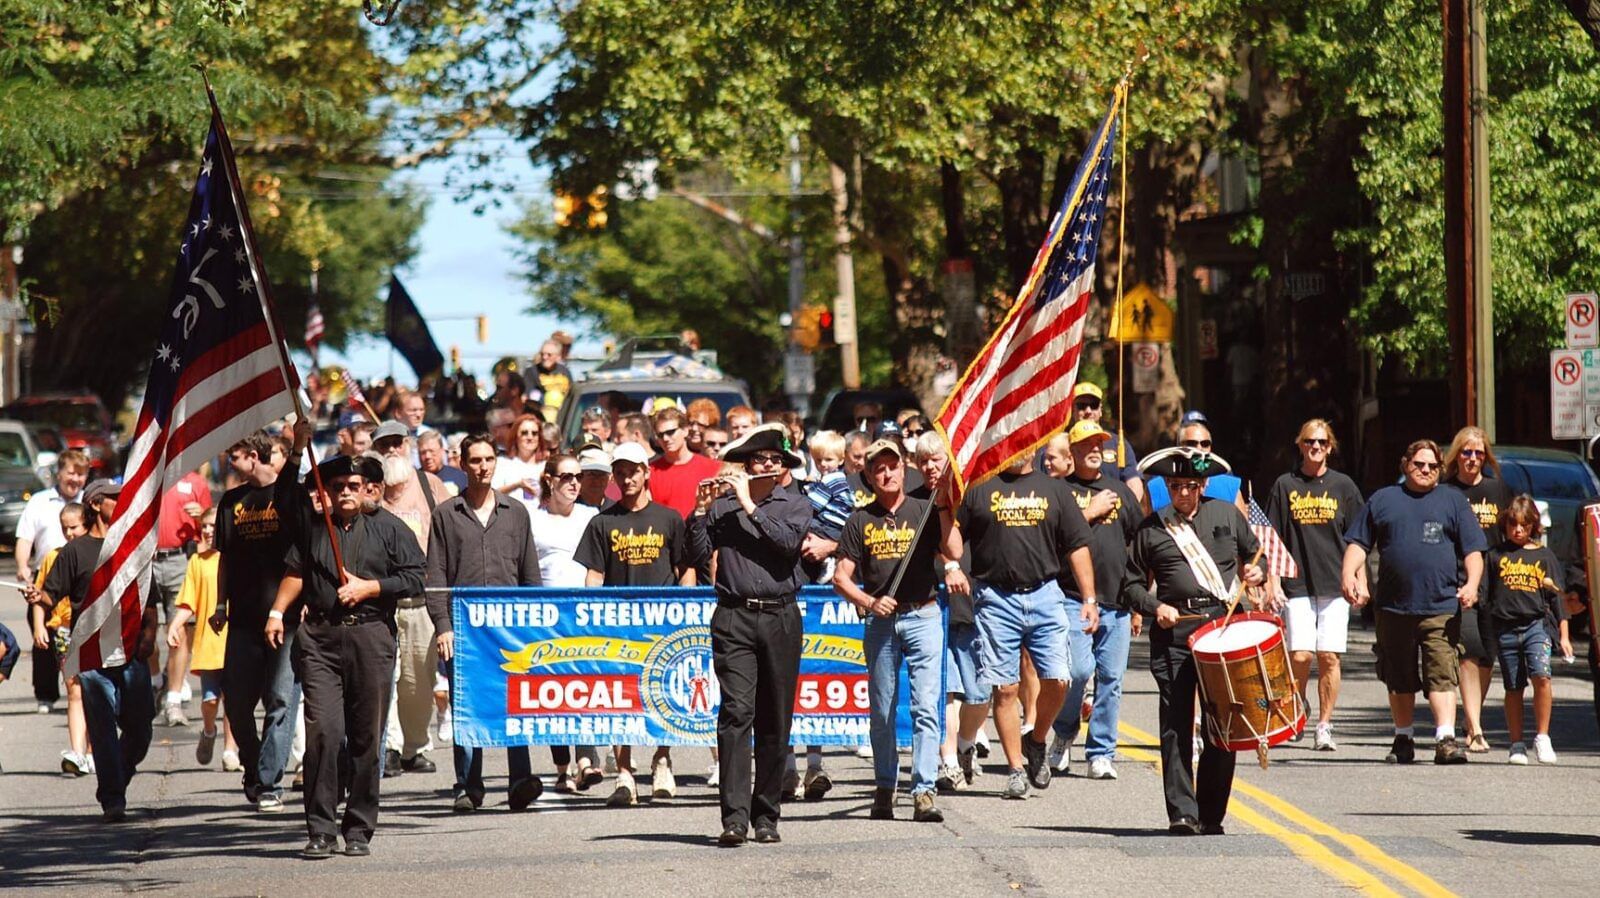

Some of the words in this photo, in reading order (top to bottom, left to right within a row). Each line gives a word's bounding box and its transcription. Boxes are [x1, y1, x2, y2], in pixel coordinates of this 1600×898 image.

[996, 510, 1025, 521] LOCAL
[1026, 509, 1045, 520] 2599
[1293, 509, 1319, 520] LOCAL
[469, 603, 559, 627] UNITED
[575, 602, 717, 626] STEELWORK
[531, 640, 608, 665] Proud
[617, 644, 640, 660] to
[519, 680, 633, 709] LOCAL
[505, 715, 648, 737] BETHLEHEM
